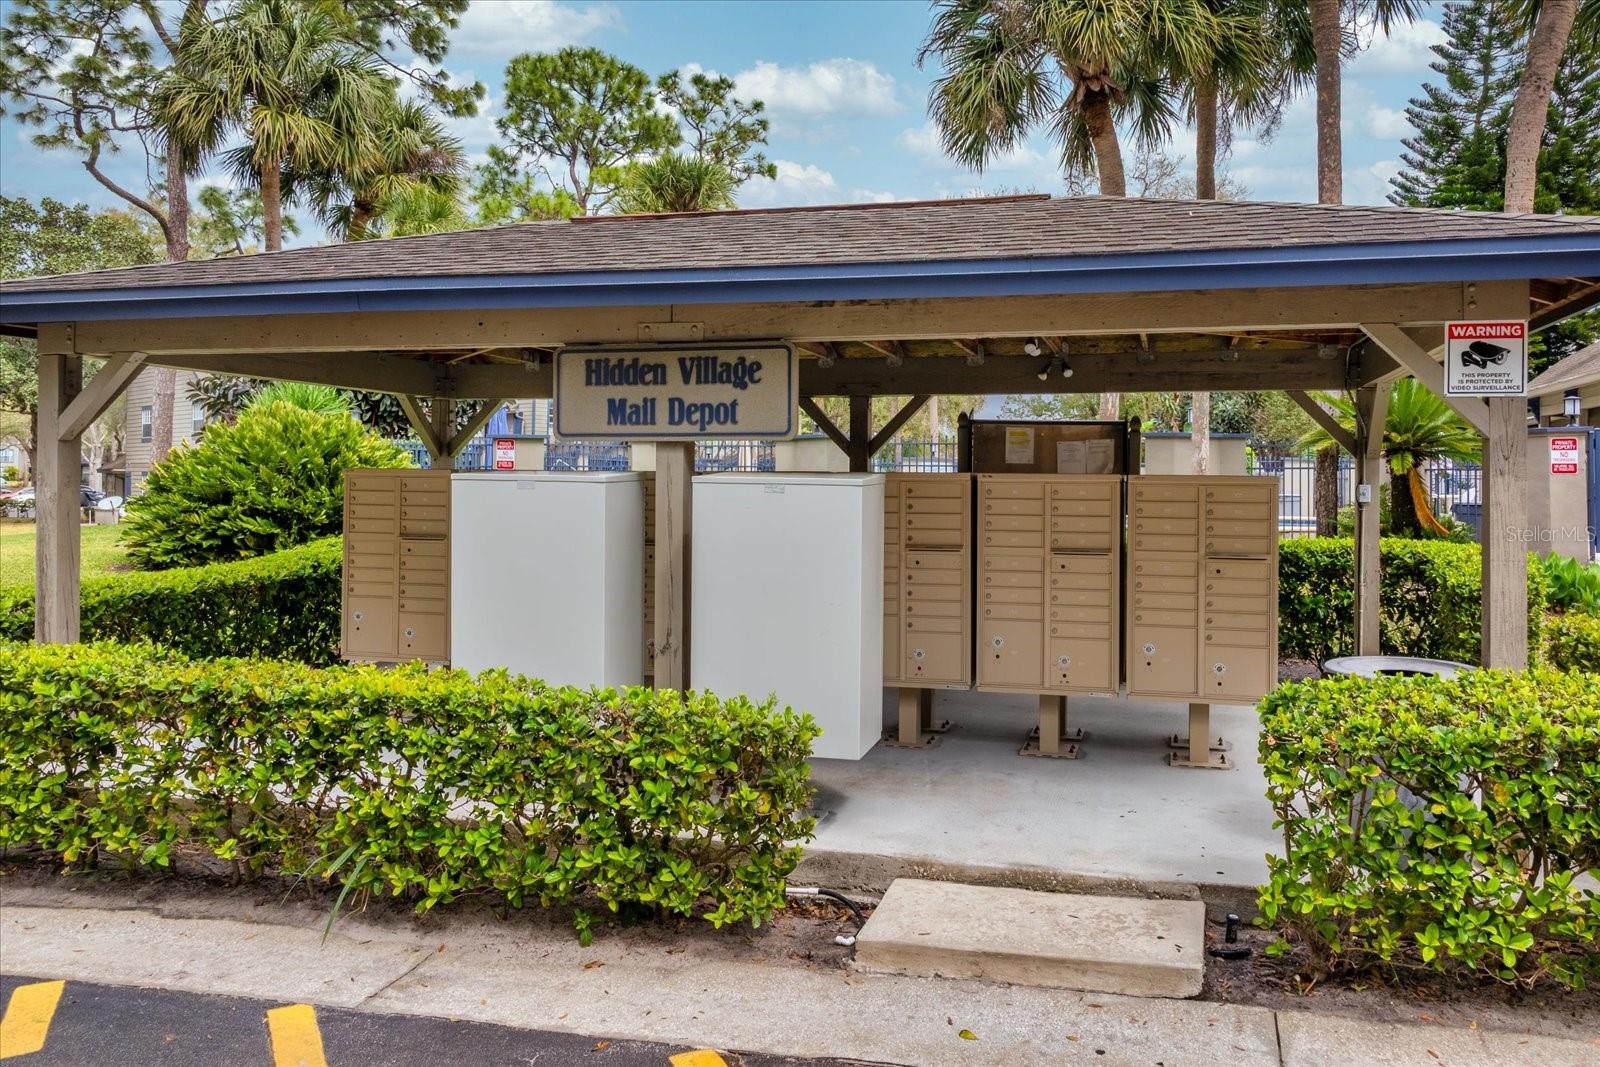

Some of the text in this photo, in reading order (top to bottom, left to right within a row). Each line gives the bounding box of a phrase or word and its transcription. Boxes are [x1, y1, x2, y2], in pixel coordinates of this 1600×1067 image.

[1451, 325, 1522, 337] WARNING
[585, 356, 762, 390] Hidden Village
[607, 397, 739, 431] Mail Depot
